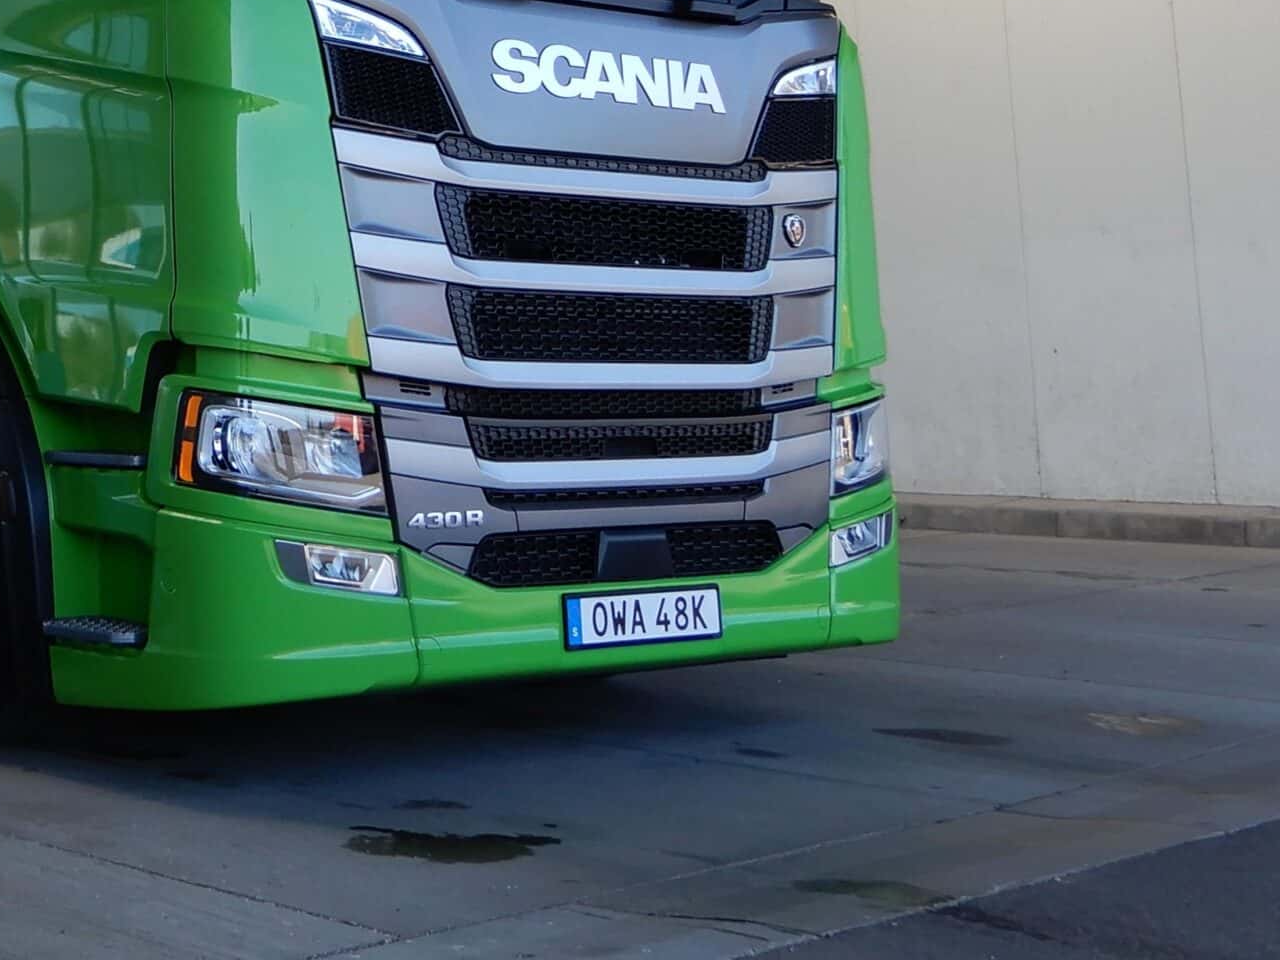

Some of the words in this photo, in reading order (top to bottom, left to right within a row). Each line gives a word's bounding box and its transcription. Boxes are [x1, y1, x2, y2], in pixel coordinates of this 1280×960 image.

[491, 39, 726, 113] SCANIA
[592, 600, 646, 637] OWA
[656, 595, 707, 632] 48K
